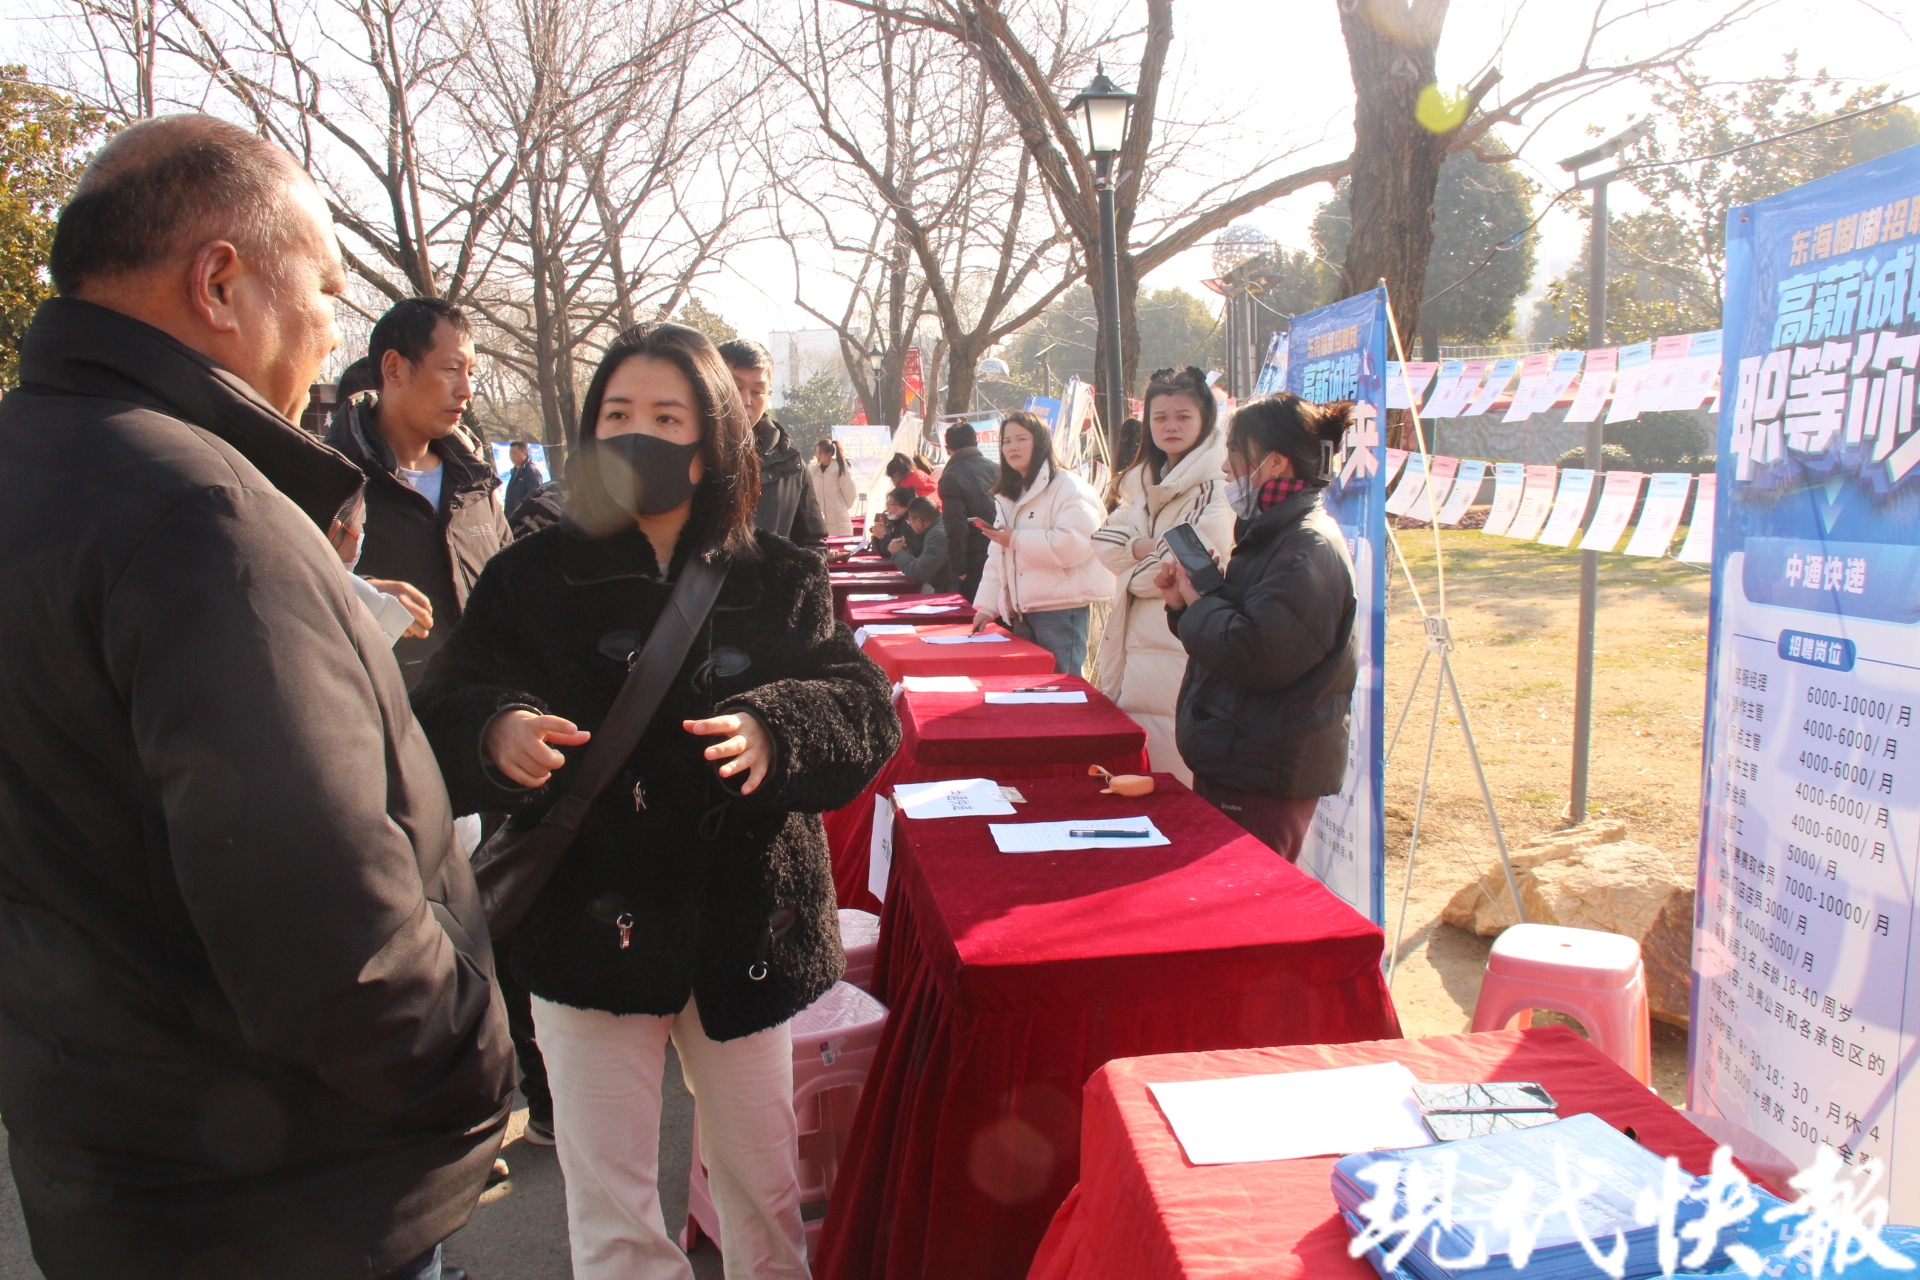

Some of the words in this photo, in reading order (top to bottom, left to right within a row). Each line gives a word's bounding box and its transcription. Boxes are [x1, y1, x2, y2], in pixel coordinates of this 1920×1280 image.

[1730, 329, 1920, 484] 职等你
[1785, 553, 1868, 594] 中通快递
[1788, 634, 1843, 666] 招聘岗位
